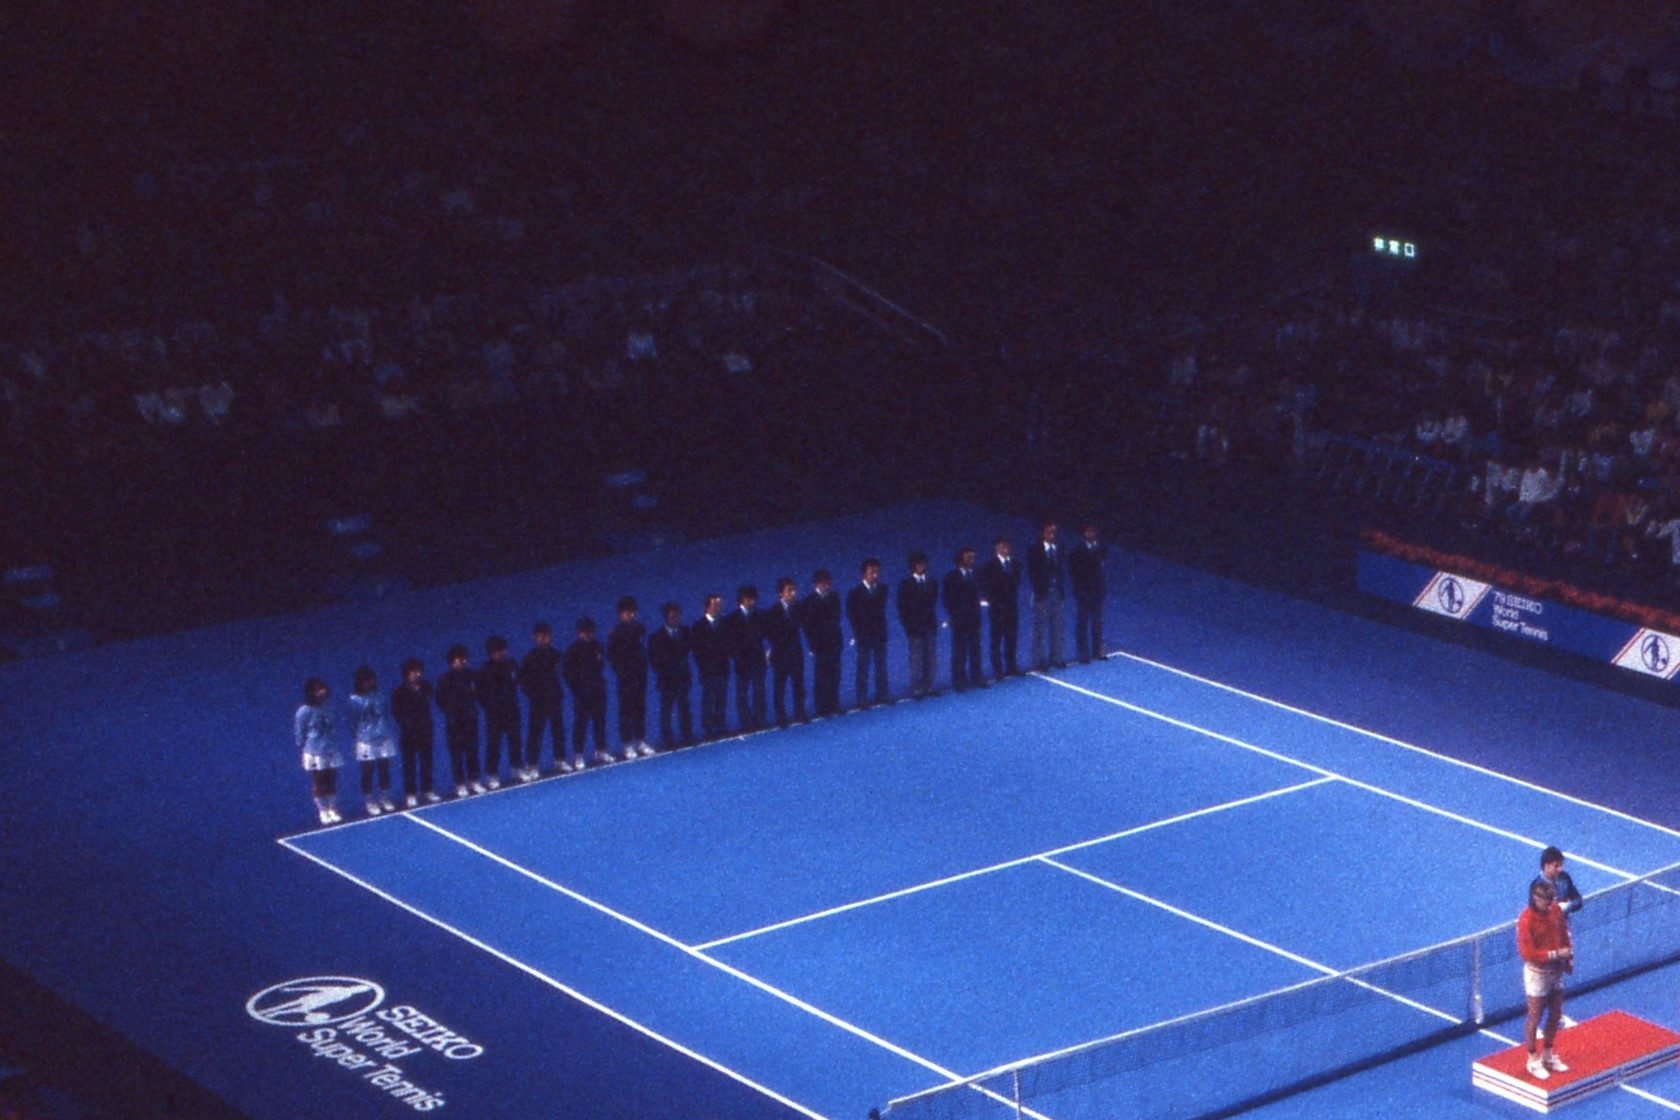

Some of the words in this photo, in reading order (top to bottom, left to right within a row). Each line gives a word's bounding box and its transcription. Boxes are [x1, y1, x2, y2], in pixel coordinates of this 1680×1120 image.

[1492, 603, 1519, 621] World
[1506, 594, 1543, 615] SEIKO
[1491, 614, 1519, 631] Super
[1519, 622, 1549, 641] Tennis
[336, 1015, 423, 1060] World
[374, 1004, 485, 1060] SEIKO
[296, 1027, 378, 1070] Super
[363, 1063, 446, 1112] Tennis
